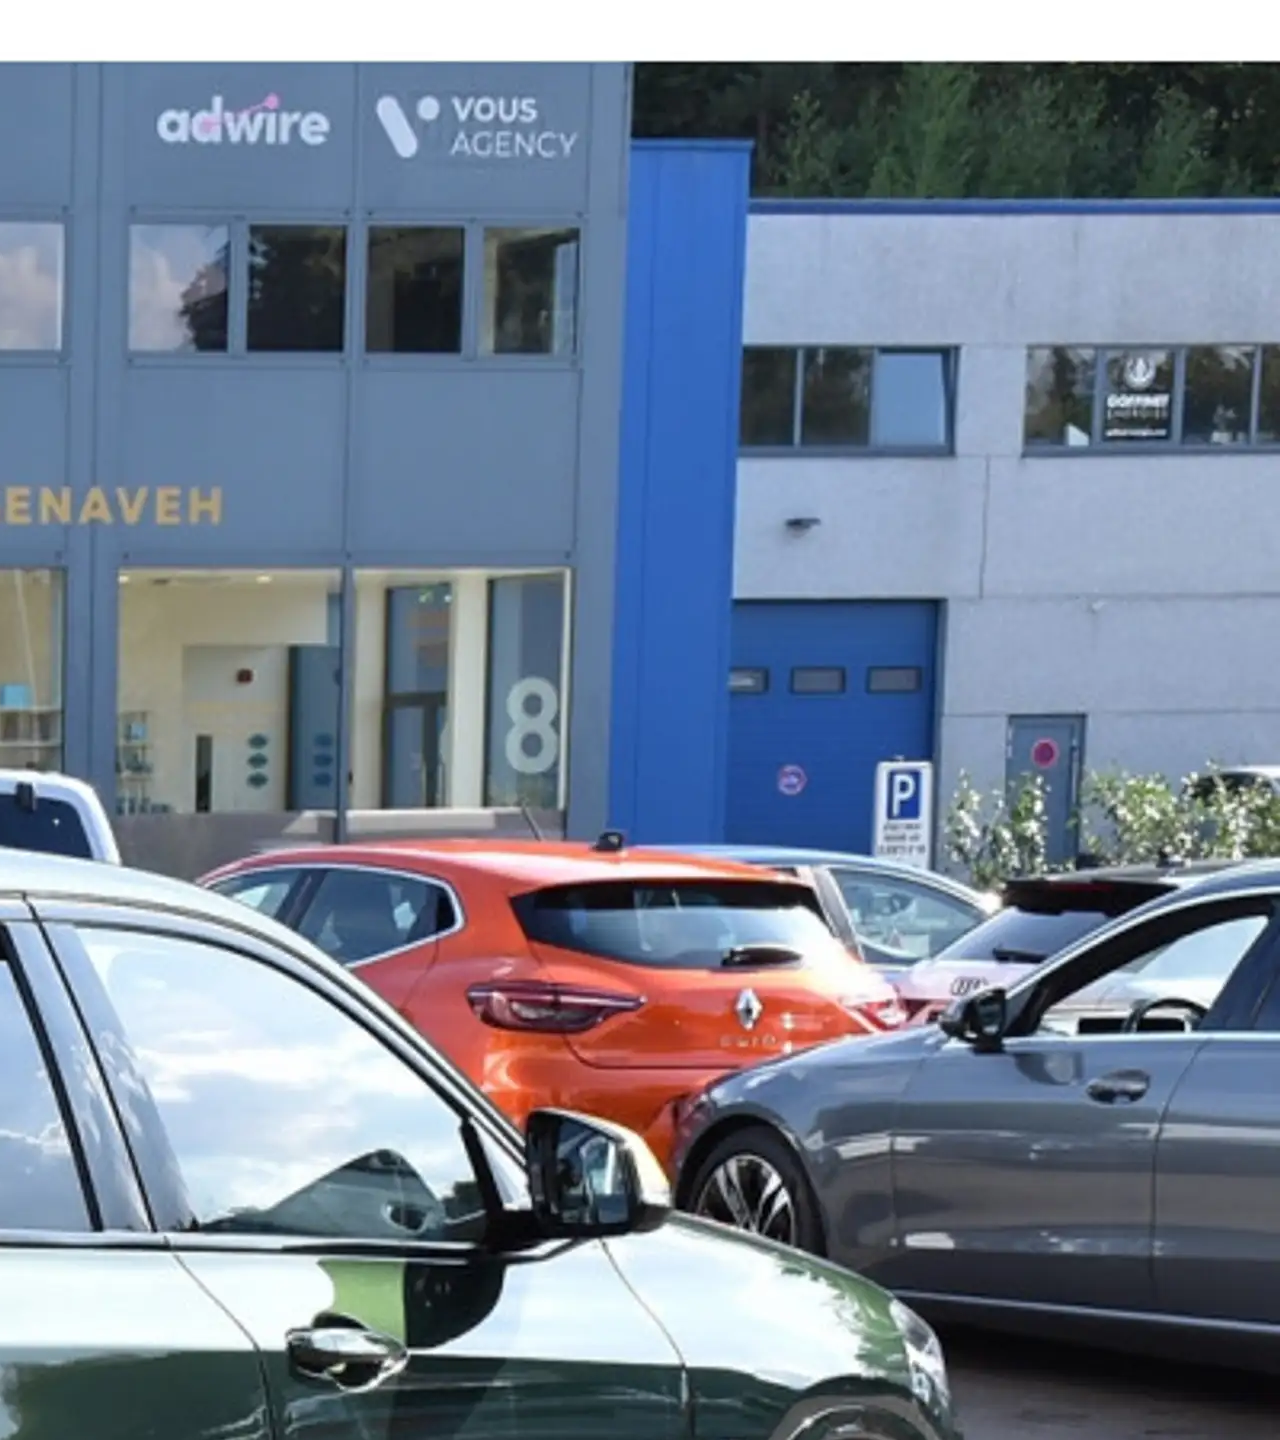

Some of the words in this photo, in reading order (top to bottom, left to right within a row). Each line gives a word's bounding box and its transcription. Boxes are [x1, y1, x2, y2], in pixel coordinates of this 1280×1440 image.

[156, 93, 330, 145] adwire
[452, 97, 538, 123] VOUS
[451, 131, 578, 158] AGENCY
[504, 676, 558, 774] 8
[893, 773, 916, 817] P
